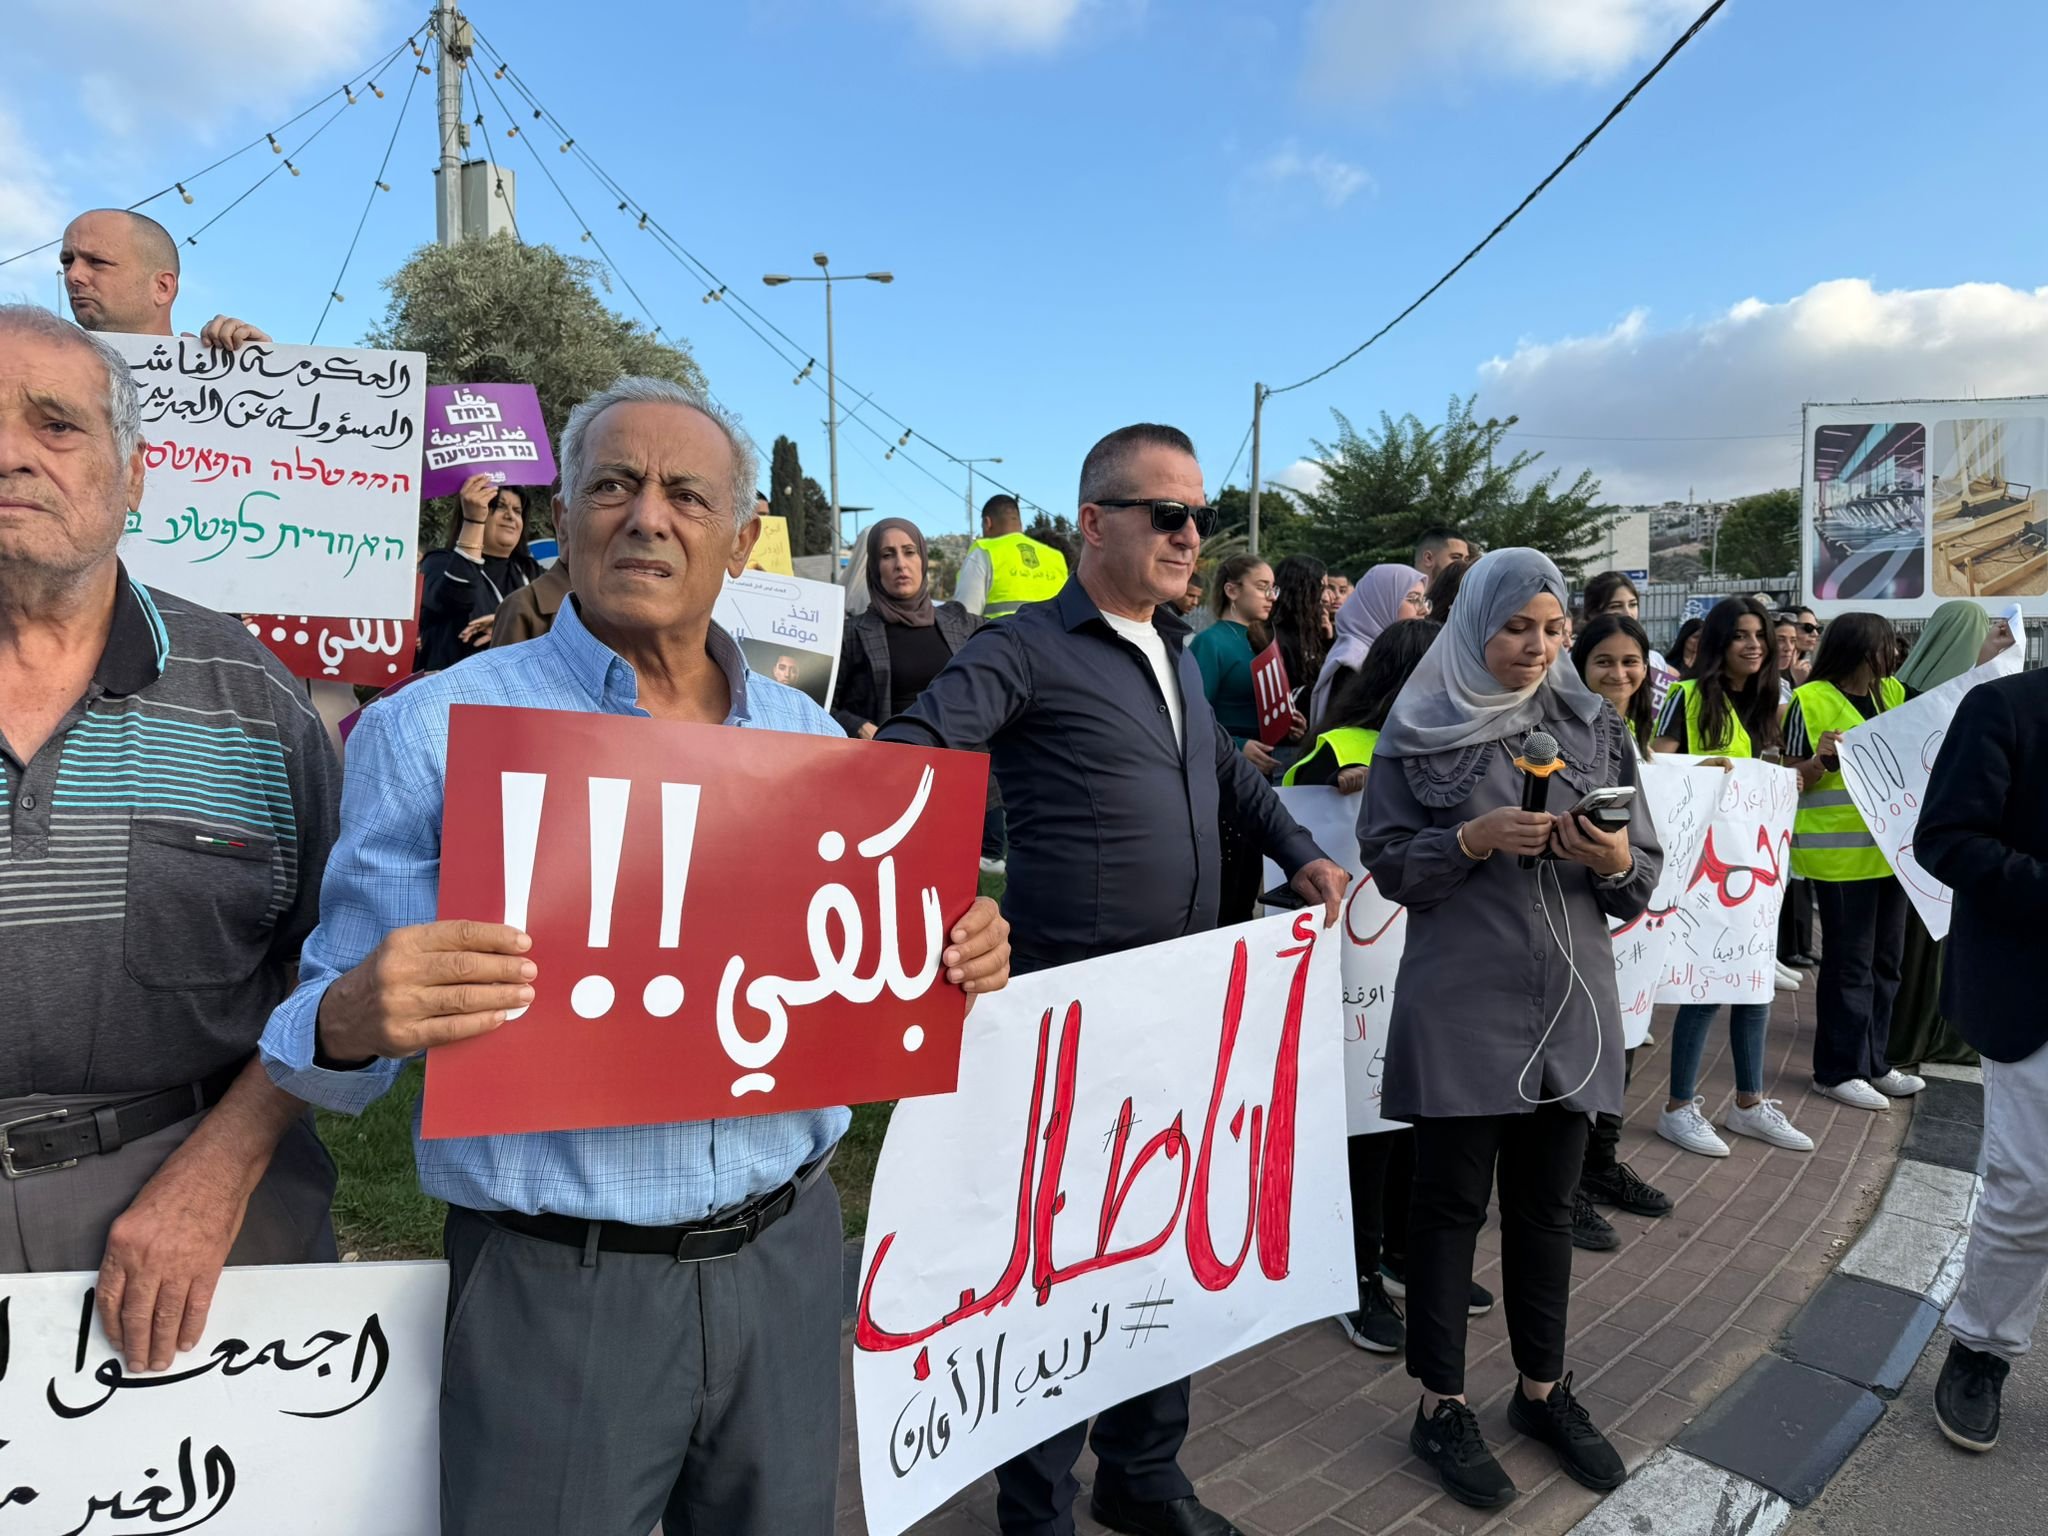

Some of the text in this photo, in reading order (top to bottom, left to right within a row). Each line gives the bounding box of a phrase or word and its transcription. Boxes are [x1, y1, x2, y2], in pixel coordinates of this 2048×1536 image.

[130, 340, 410, 398] الحكومة الفاش
[225, 389, 284, 428] عن
[267, 393, 413, 449] المسؤولة
[451, 407, 497, 420] ביחד
[430, 424, 527, 447] ضد الجريمة
[432, 445, 534, 466] נגד הפשיעה
[145, 440, 410, 493] הממשלה הפאשס
[147, 490, 281, 563] לפשע
[787, 604, 819, 623] اتخذ
[46, 1286, 390, 1419] اجمعوا
